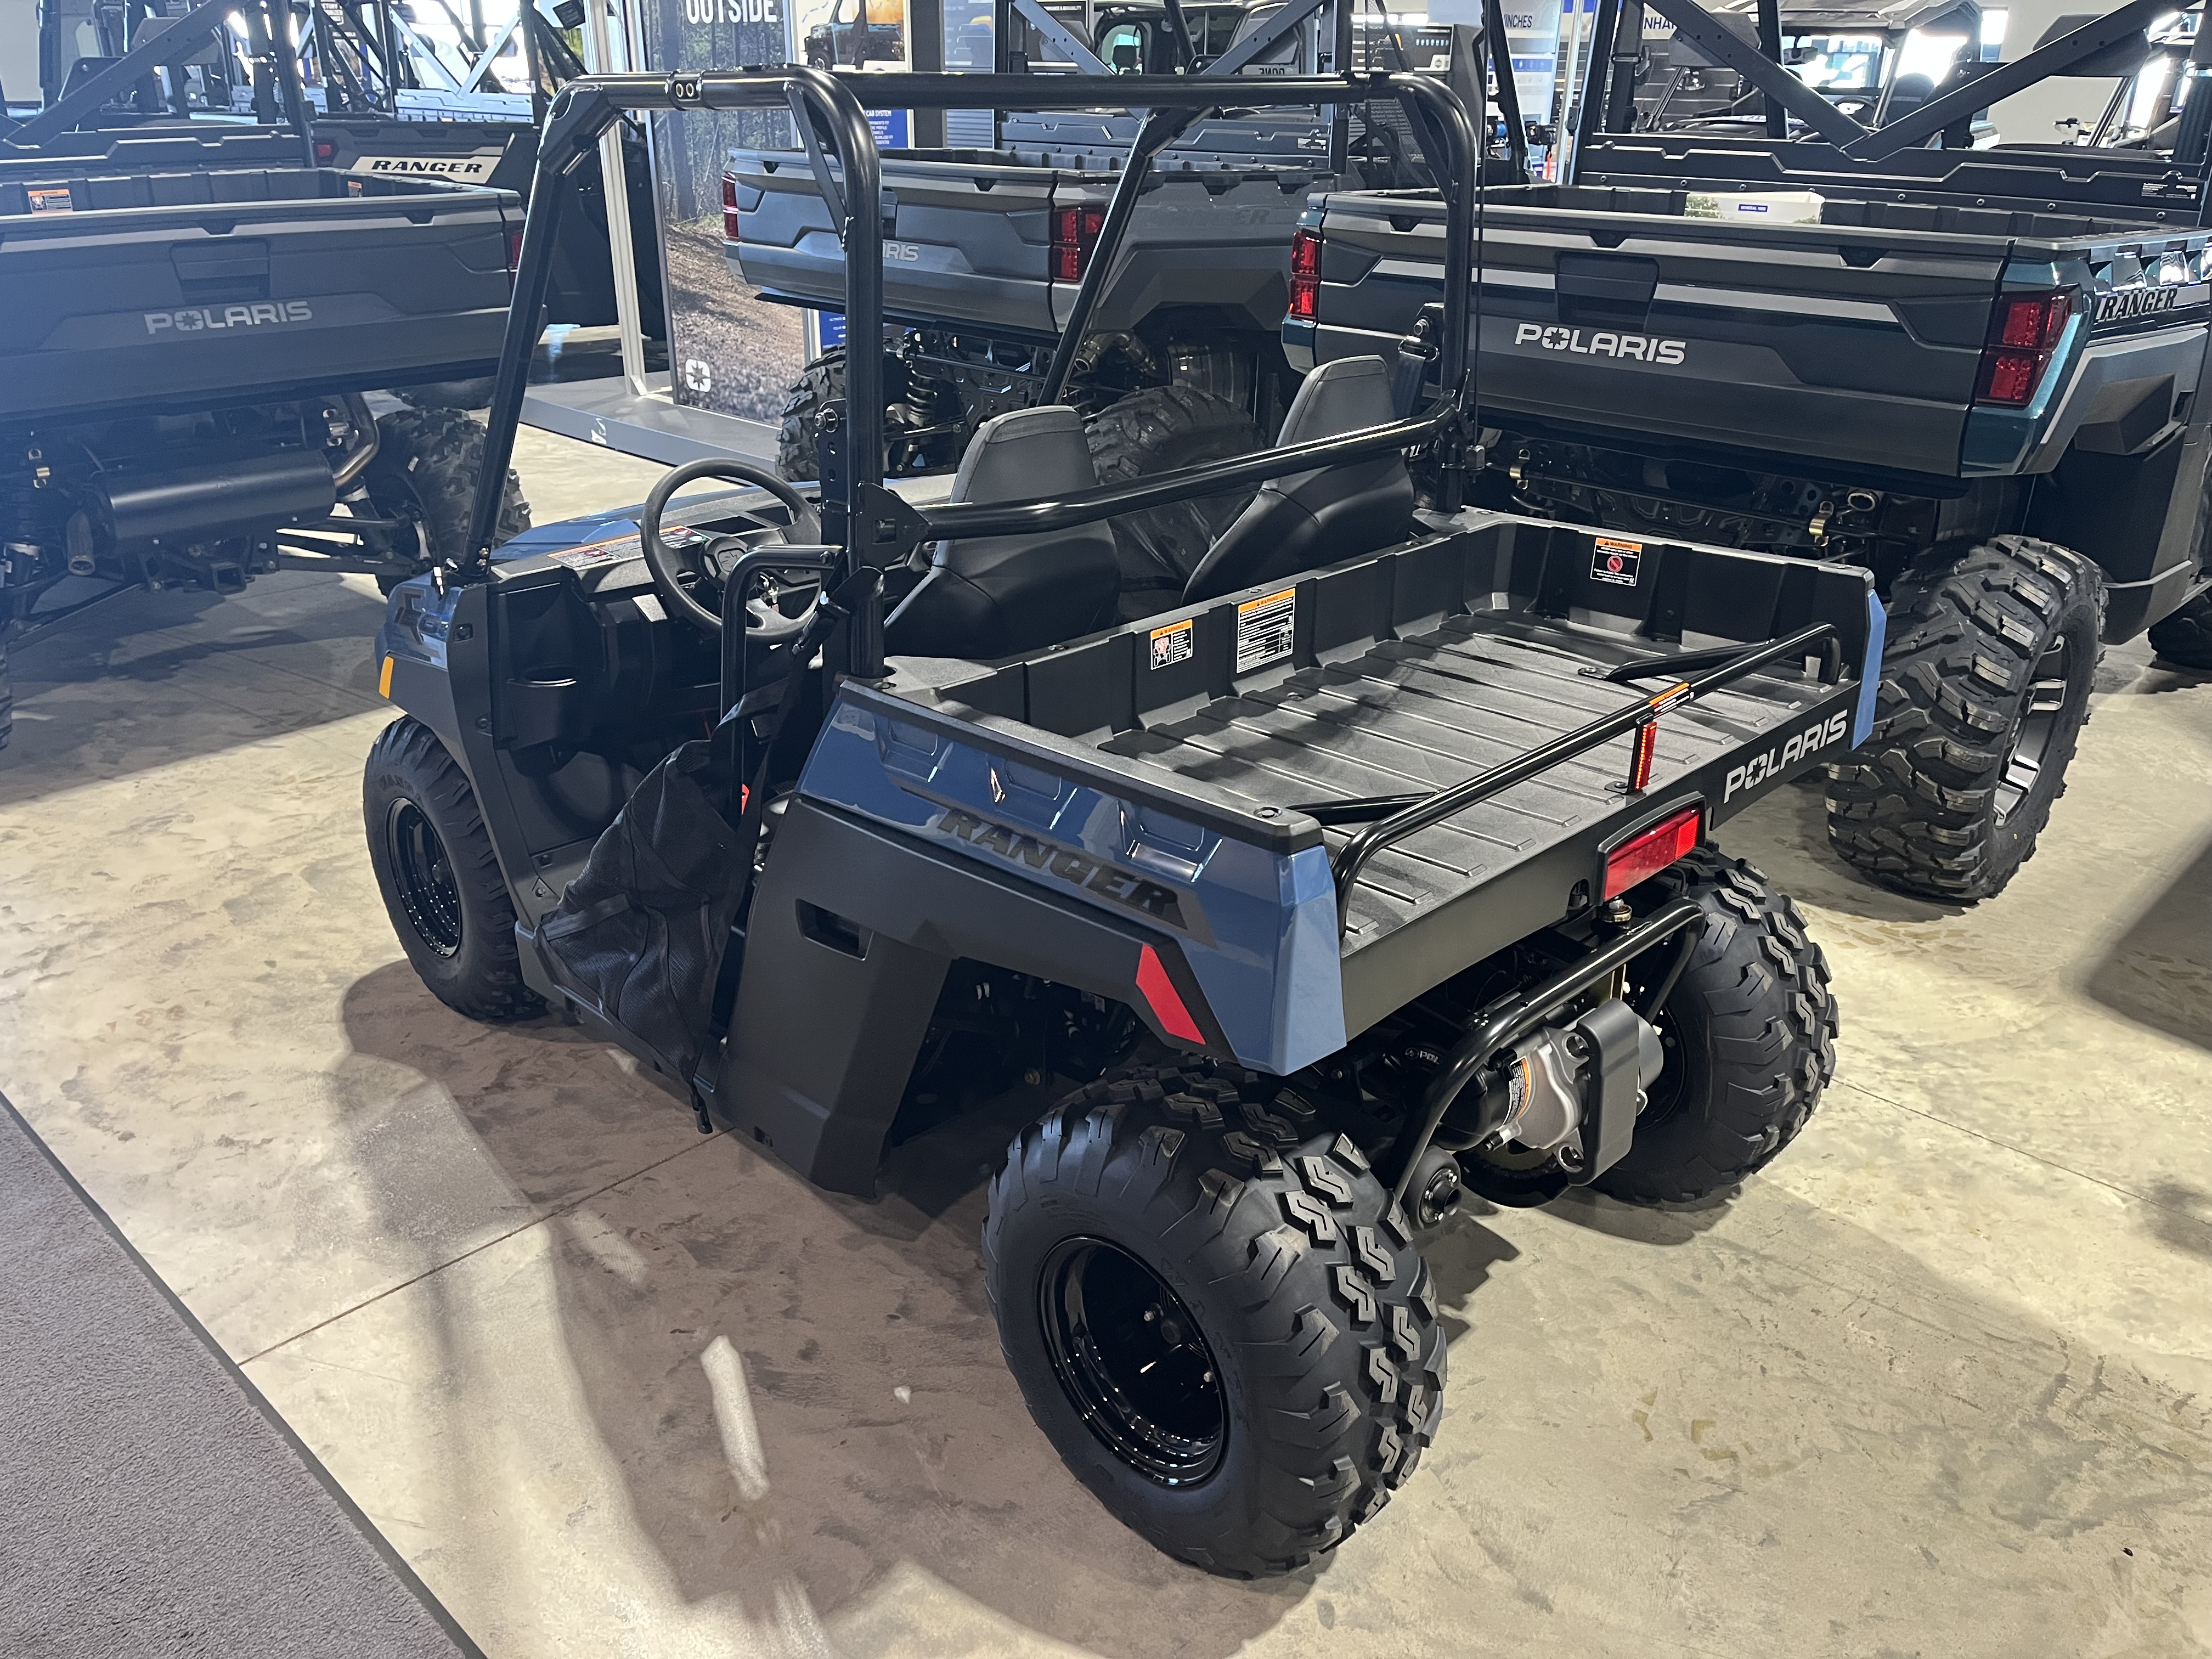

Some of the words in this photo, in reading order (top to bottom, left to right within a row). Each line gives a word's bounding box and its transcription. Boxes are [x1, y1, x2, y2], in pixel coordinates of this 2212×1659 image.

[686, 0, 777, 24] OUTSIDE
[371, 160, 483, 173] RANGER
[144, 301, 312, 334] POLARIS
[2099, 286, 2179, 321] RANGER
[1515, 323, 1686, 365] POLARIS
[1724, 709, 1848, 804] POLARIS
[937, 808, 1181, 919] RANGER
